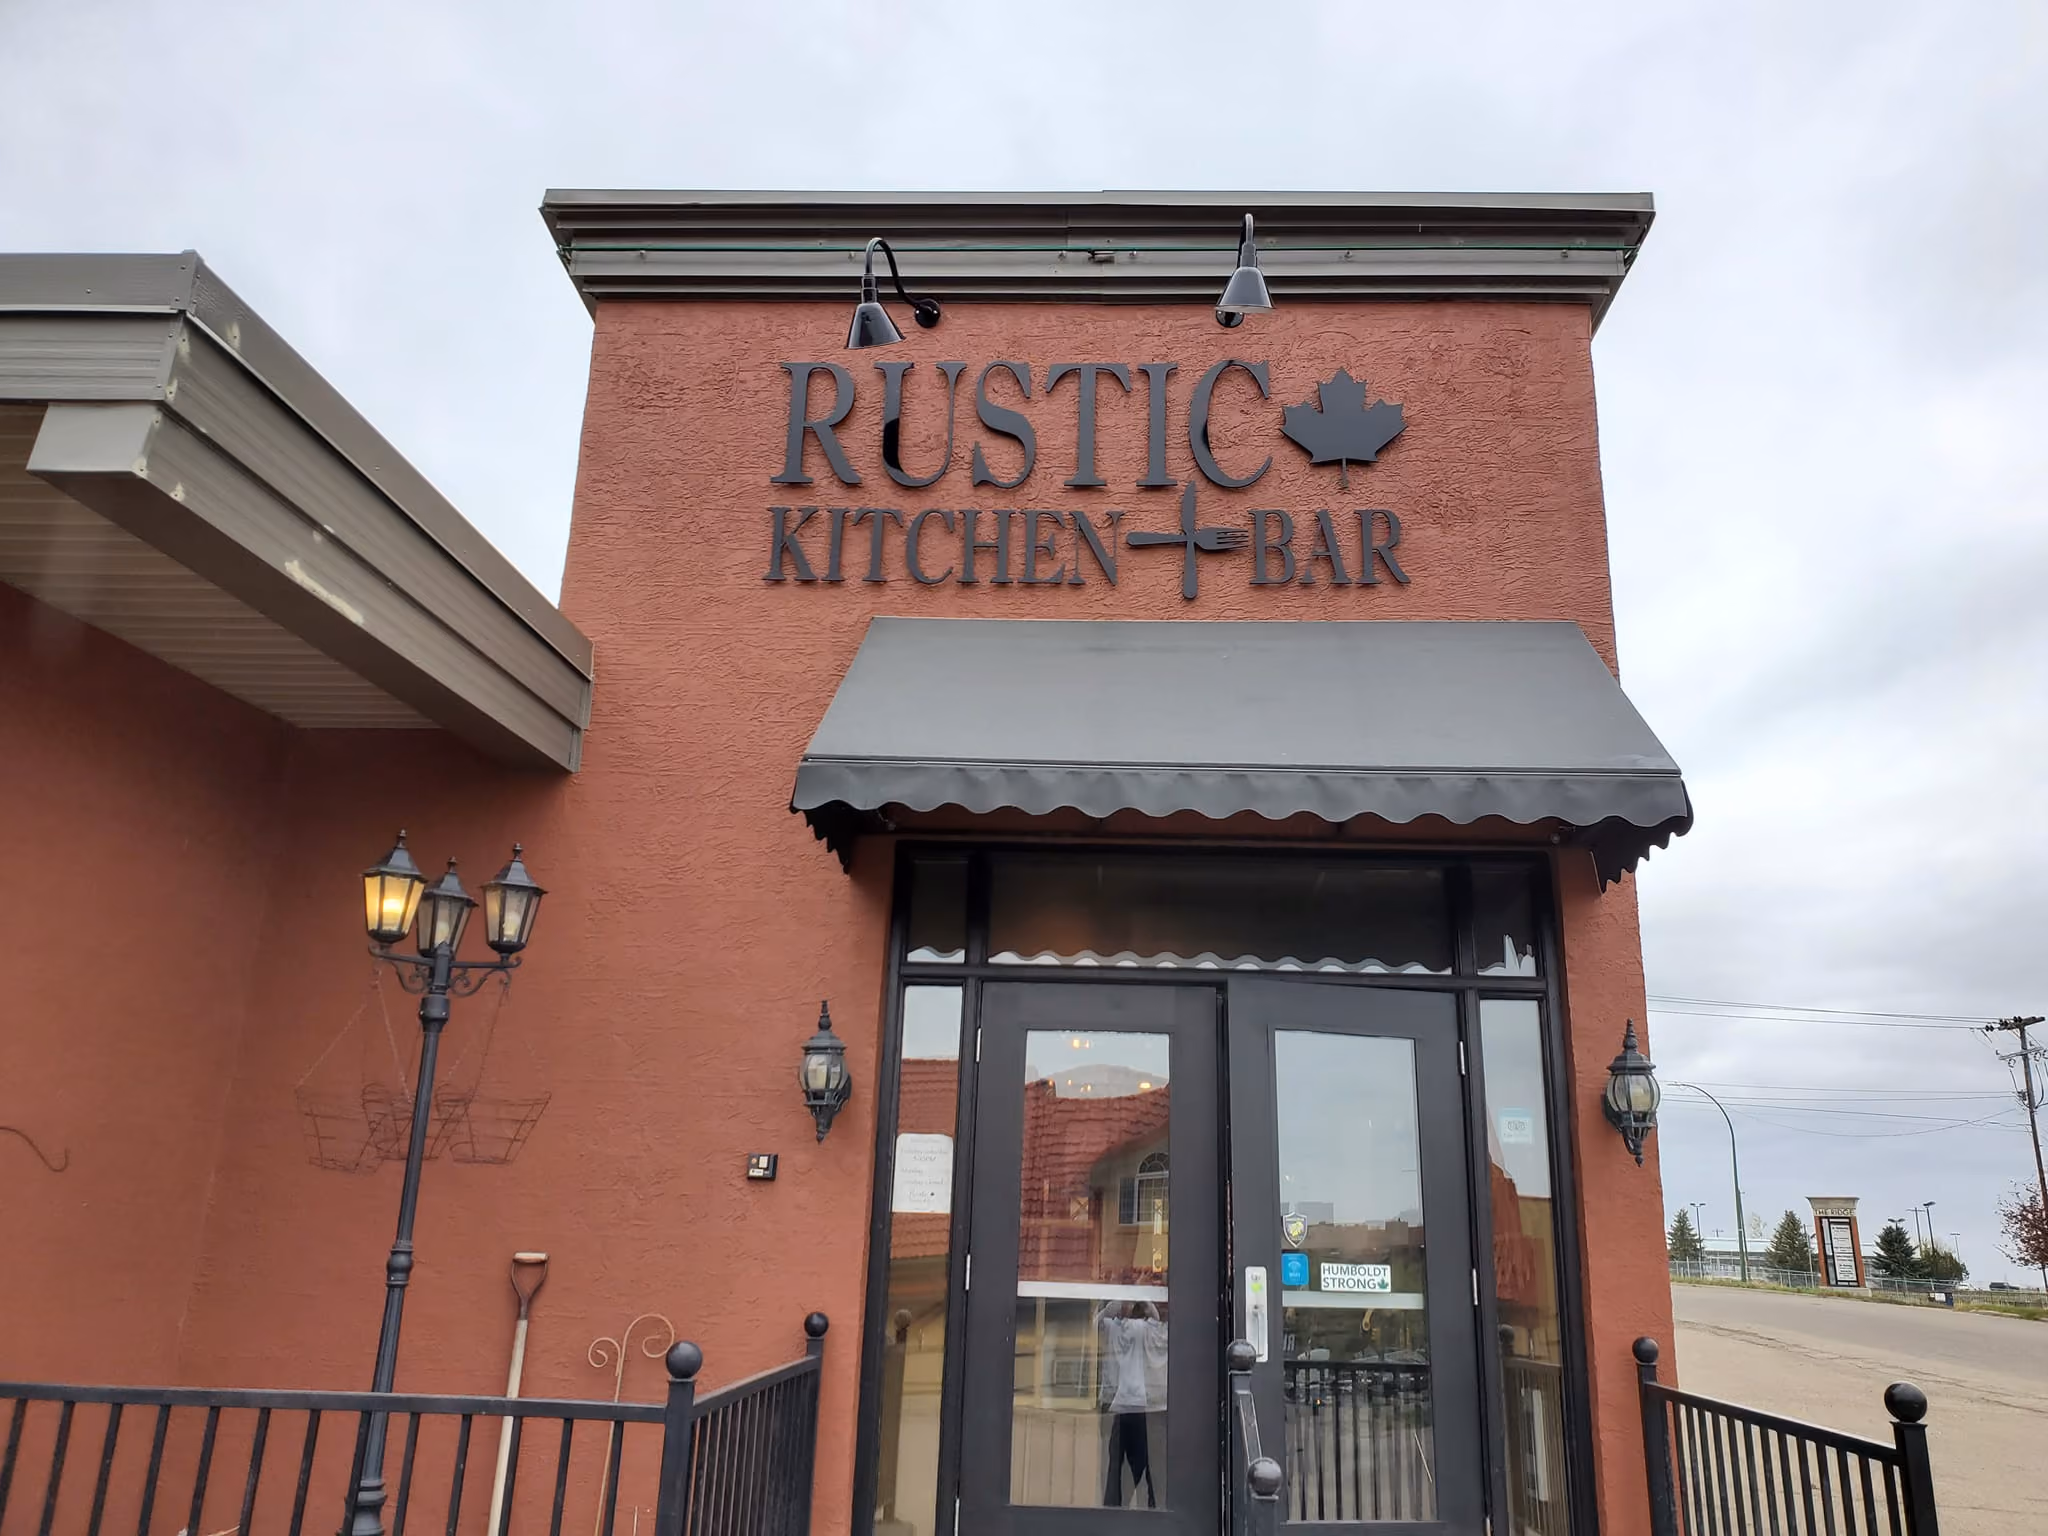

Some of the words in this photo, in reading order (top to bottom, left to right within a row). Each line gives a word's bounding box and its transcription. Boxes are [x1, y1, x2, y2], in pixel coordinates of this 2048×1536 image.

[769, 359, 1273, 488] RUSTIC
[762, 506, 1124, 586] KITCHEN
[1247, 508, 1411, 585] BAR
[1815, 1208, 1828, 1216] THE
[1830, 1208, 1855, 1216] RIDGE
[1322, 1264, 1389, 1277] HUMBOLDT
[1322, 1277, 1377, 1289] STRONG
